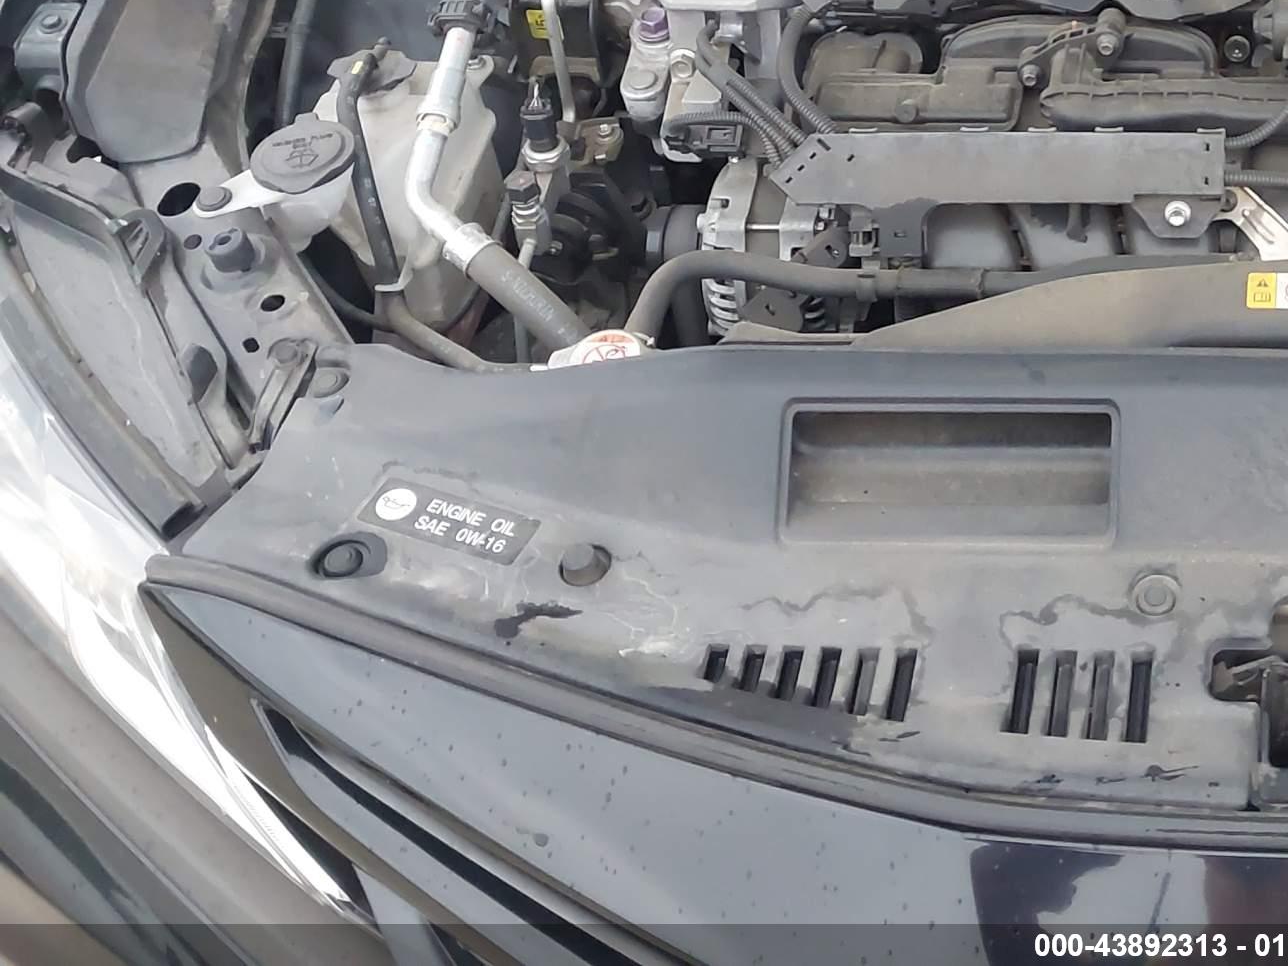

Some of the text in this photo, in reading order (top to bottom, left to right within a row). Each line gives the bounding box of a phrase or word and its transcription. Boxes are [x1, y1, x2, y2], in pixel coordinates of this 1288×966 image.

[414, 515, 506, 553] SAE 0W-16
[426, 498, 515, 537] ENGINE OIL
